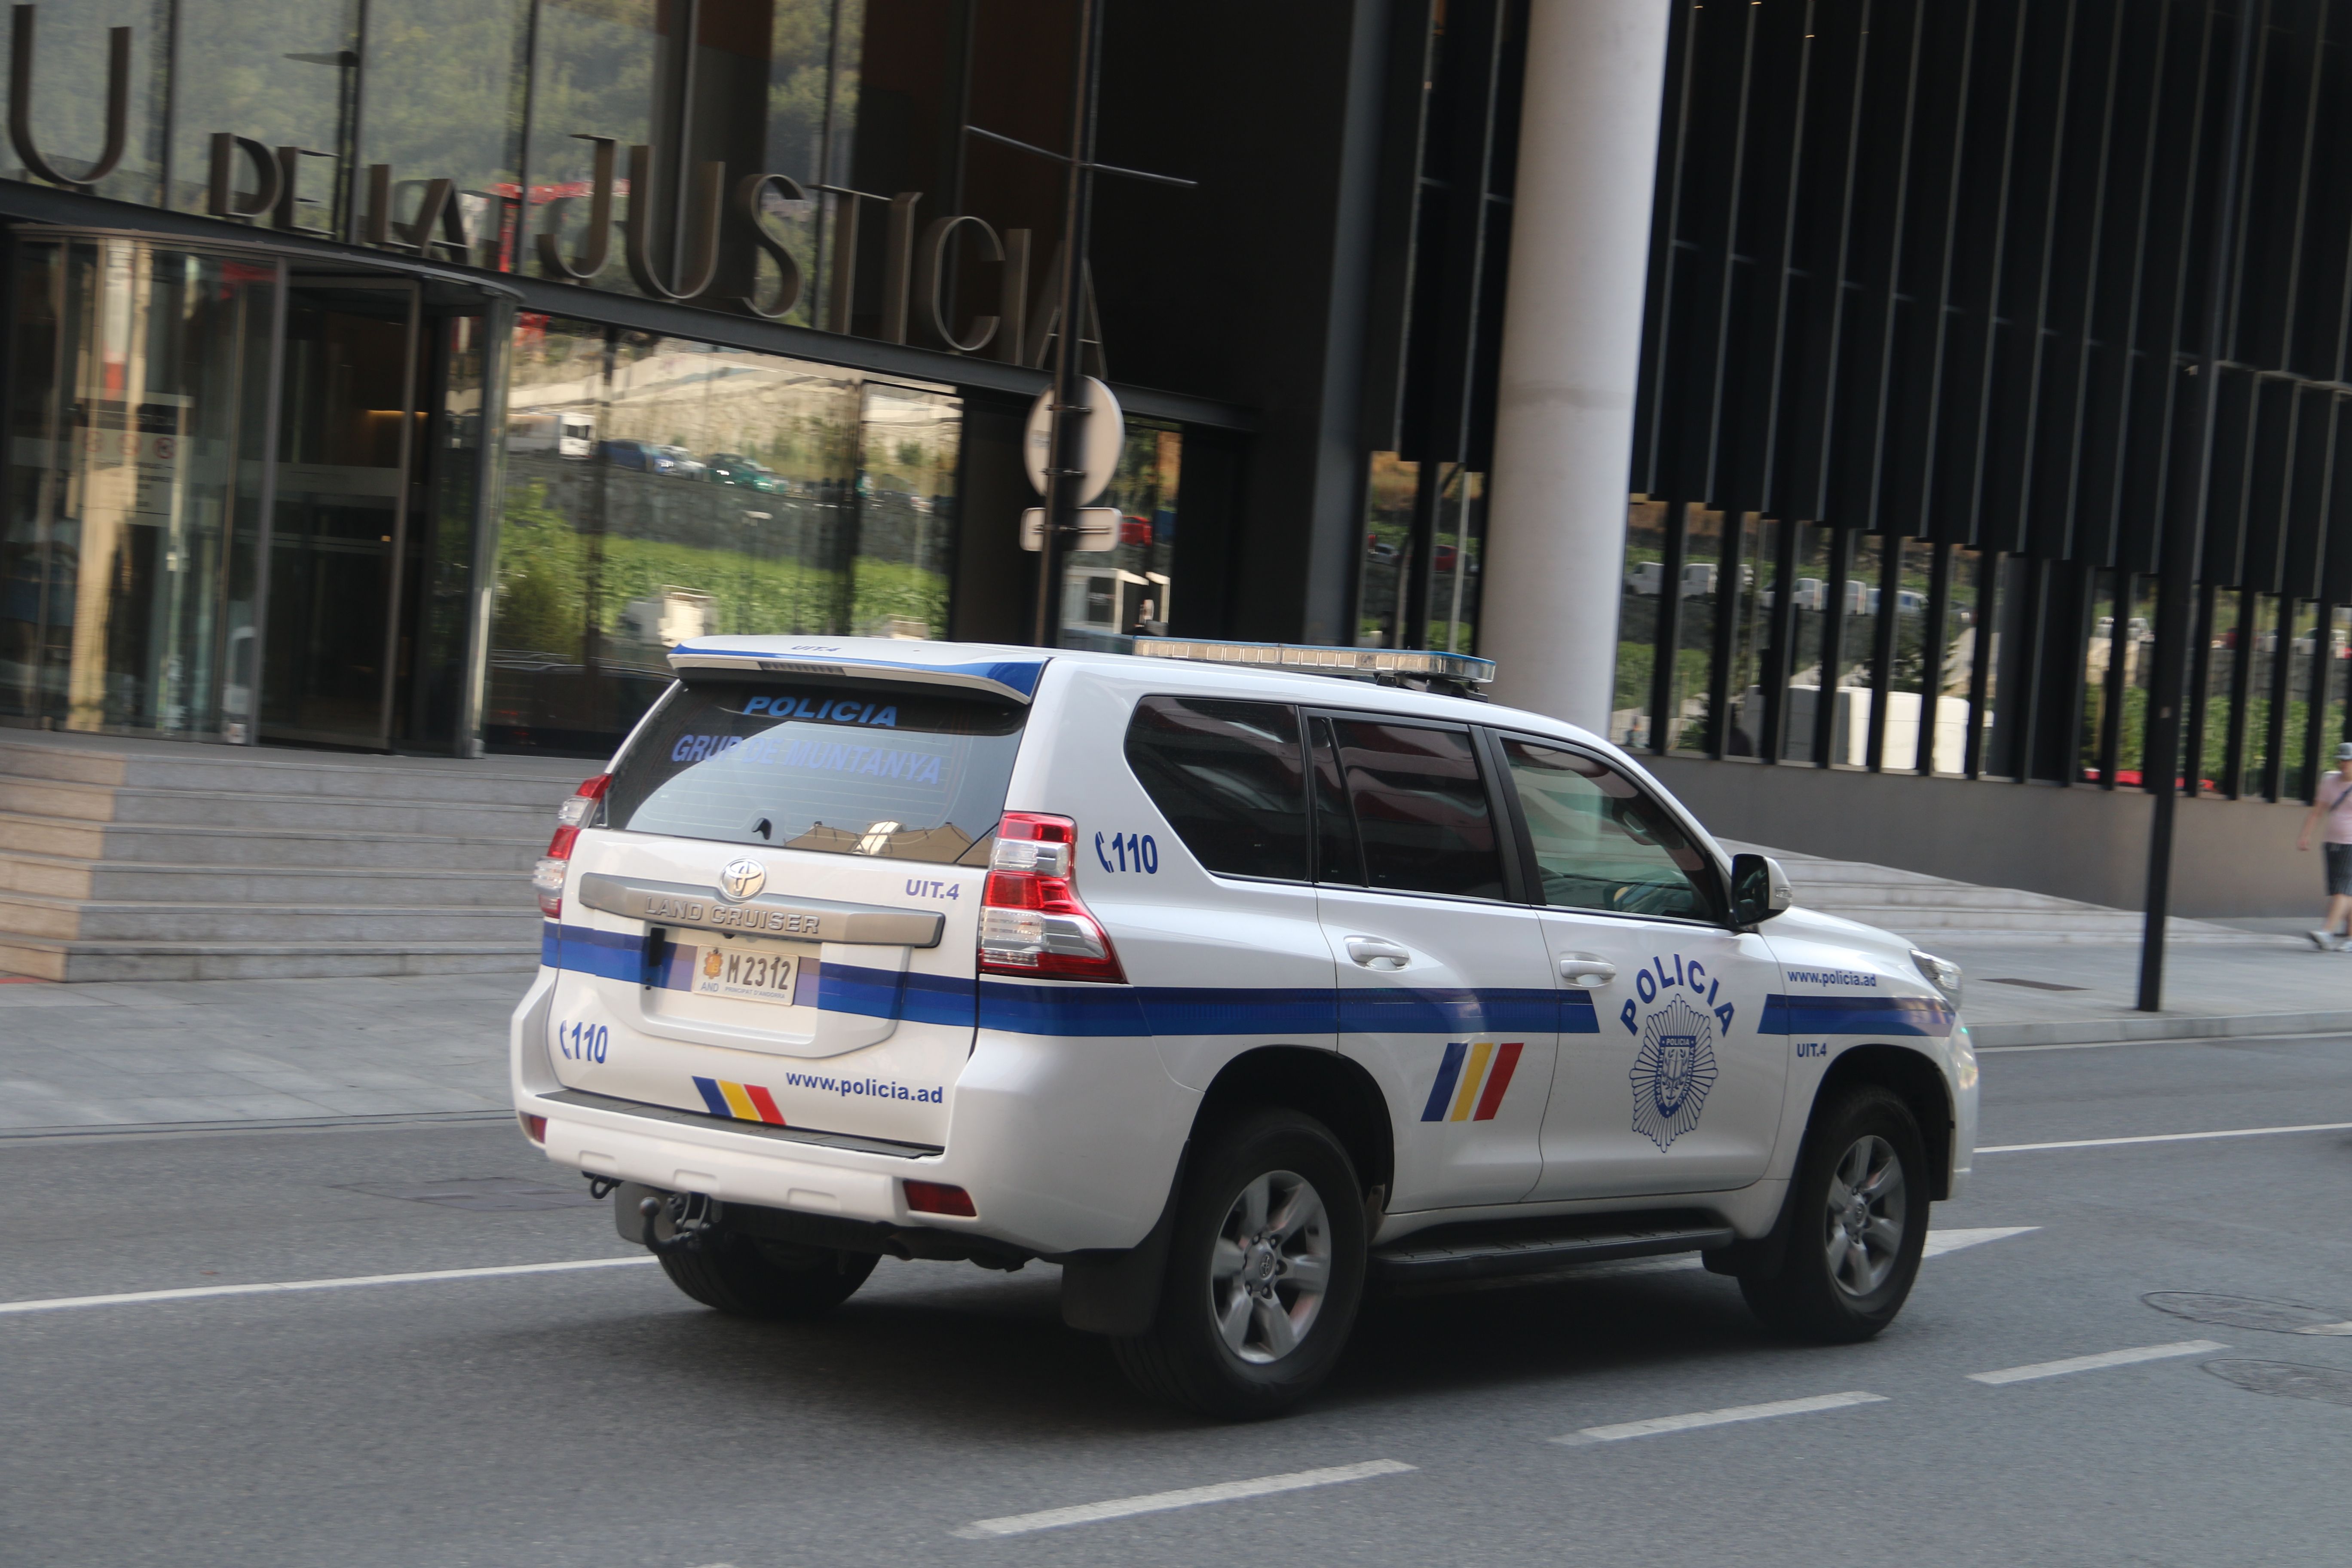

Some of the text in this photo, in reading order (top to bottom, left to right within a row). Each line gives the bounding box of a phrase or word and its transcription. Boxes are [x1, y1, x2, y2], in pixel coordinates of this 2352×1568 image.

[208, 132, 341, 236] DE
[367, 164, 469, 264] LA
[743, 696, 897, 726] POLICIA
[671, 734, 942, 785] GRUP DE MUNTANYA
[1112, 832, 1158, 874] 110
[906, 879, 960, 900] UIT.4
[645, 896, 820, 934] LAND CRUISER
[701, 982, 719, 992] AND
[1620, 953, 1734, 1037] POLICIA
[1787, 970, 1877, 987] www.policia.ad
[571, 1021, 608, 1063] 110
[1797, 1042, 1827, 1057] UIT.4
[786, 1072, 943, 1103] www.policia.ad
